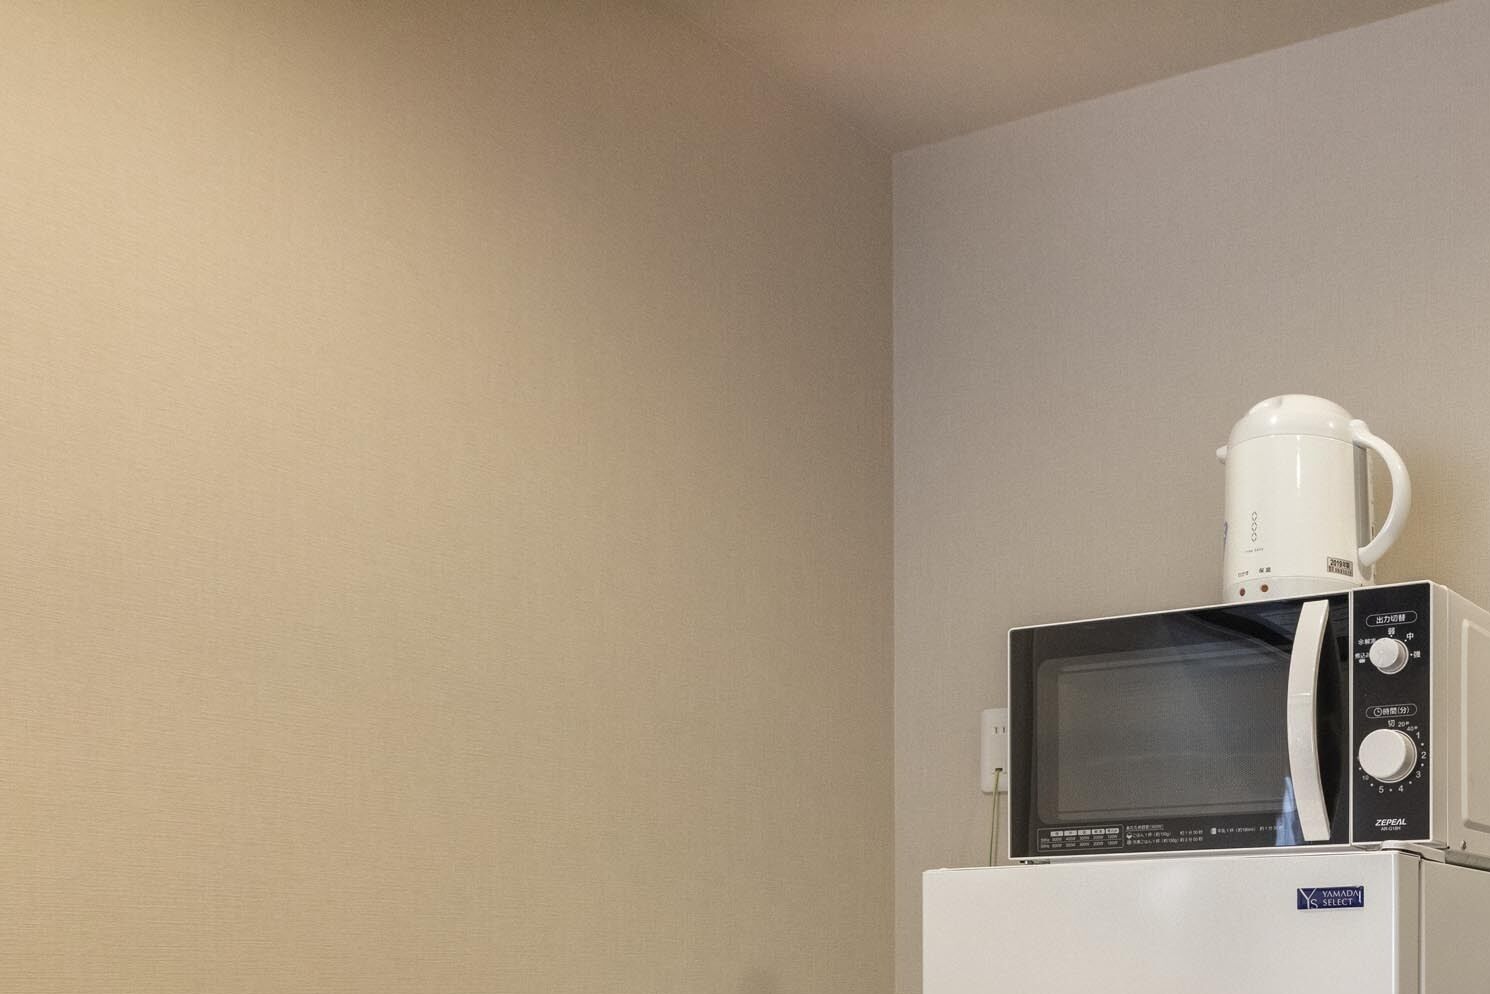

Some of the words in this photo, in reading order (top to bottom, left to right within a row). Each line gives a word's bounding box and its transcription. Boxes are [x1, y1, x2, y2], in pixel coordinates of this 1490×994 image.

[1376, 613, 1405, 624] 出力切替
[1406, 632, 1414, 640] 中
[1421, 751, 1427, 759] 2
[1416, 770, 1421, 779] 3
[1378, 785, 1384, 794] 5
[1398, 785, 1404, 793] 4
[1375, 818, 1407, 826] ZEPEAL
[1322, 889, 1358, 898] YAMADA
[1322, 898, 1353, 906] SELECT
